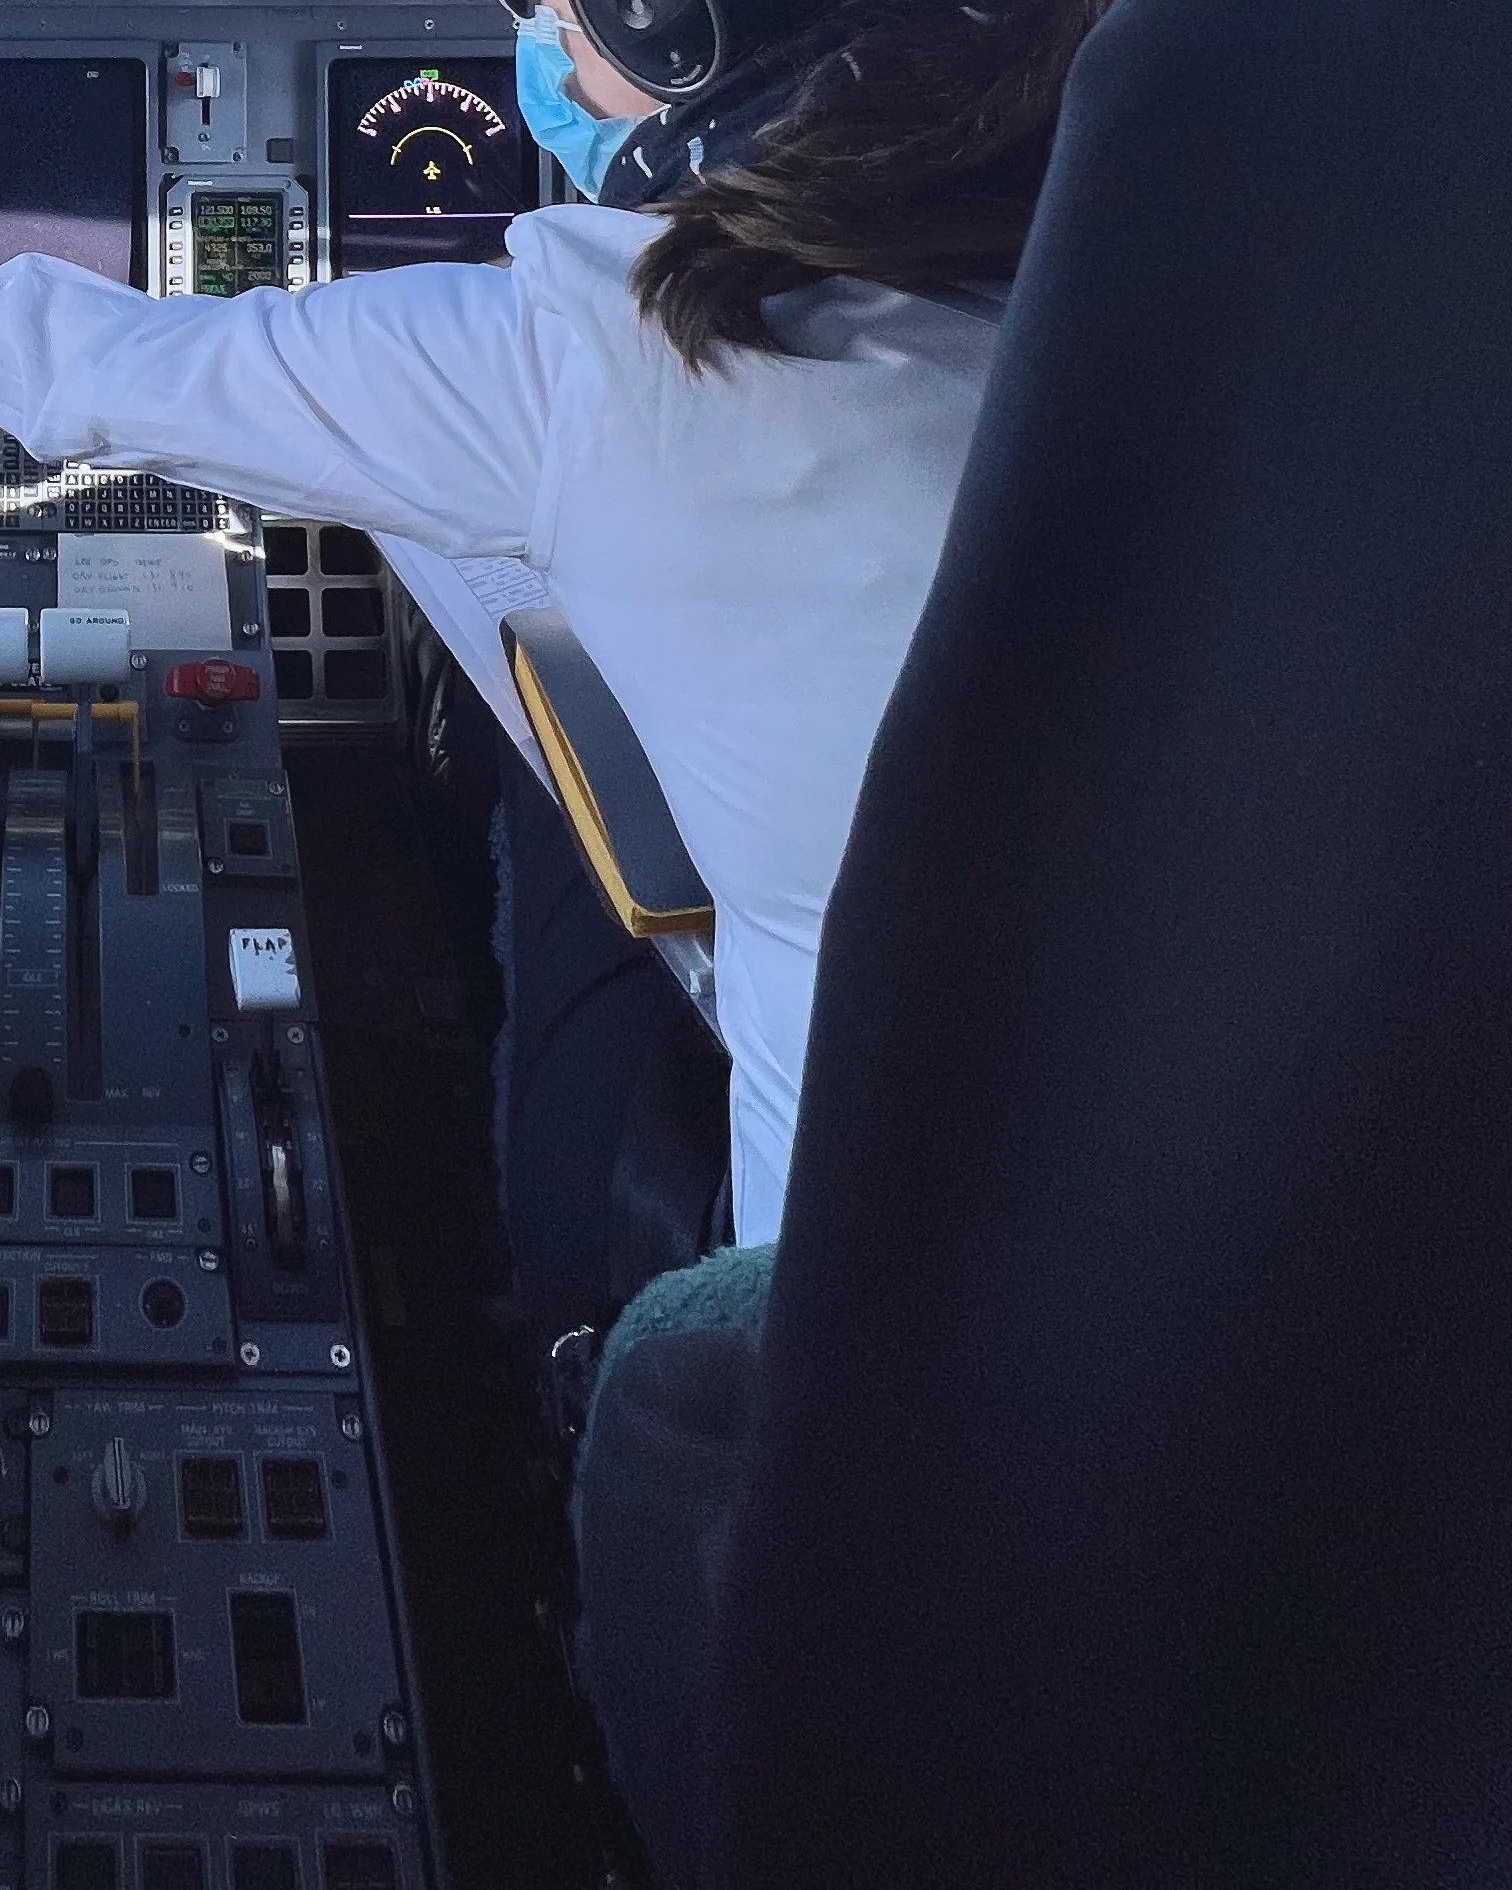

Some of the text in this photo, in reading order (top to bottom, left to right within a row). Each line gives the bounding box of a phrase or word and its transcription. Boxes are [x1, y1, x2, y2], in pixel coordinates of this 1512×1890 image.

[86, 617, 125, 625] AROUND
[162, 882, 199, 893] LOCKED
[241, 937, 288, 954] FLAP
[105, 1087, 130, 1098] MAX
